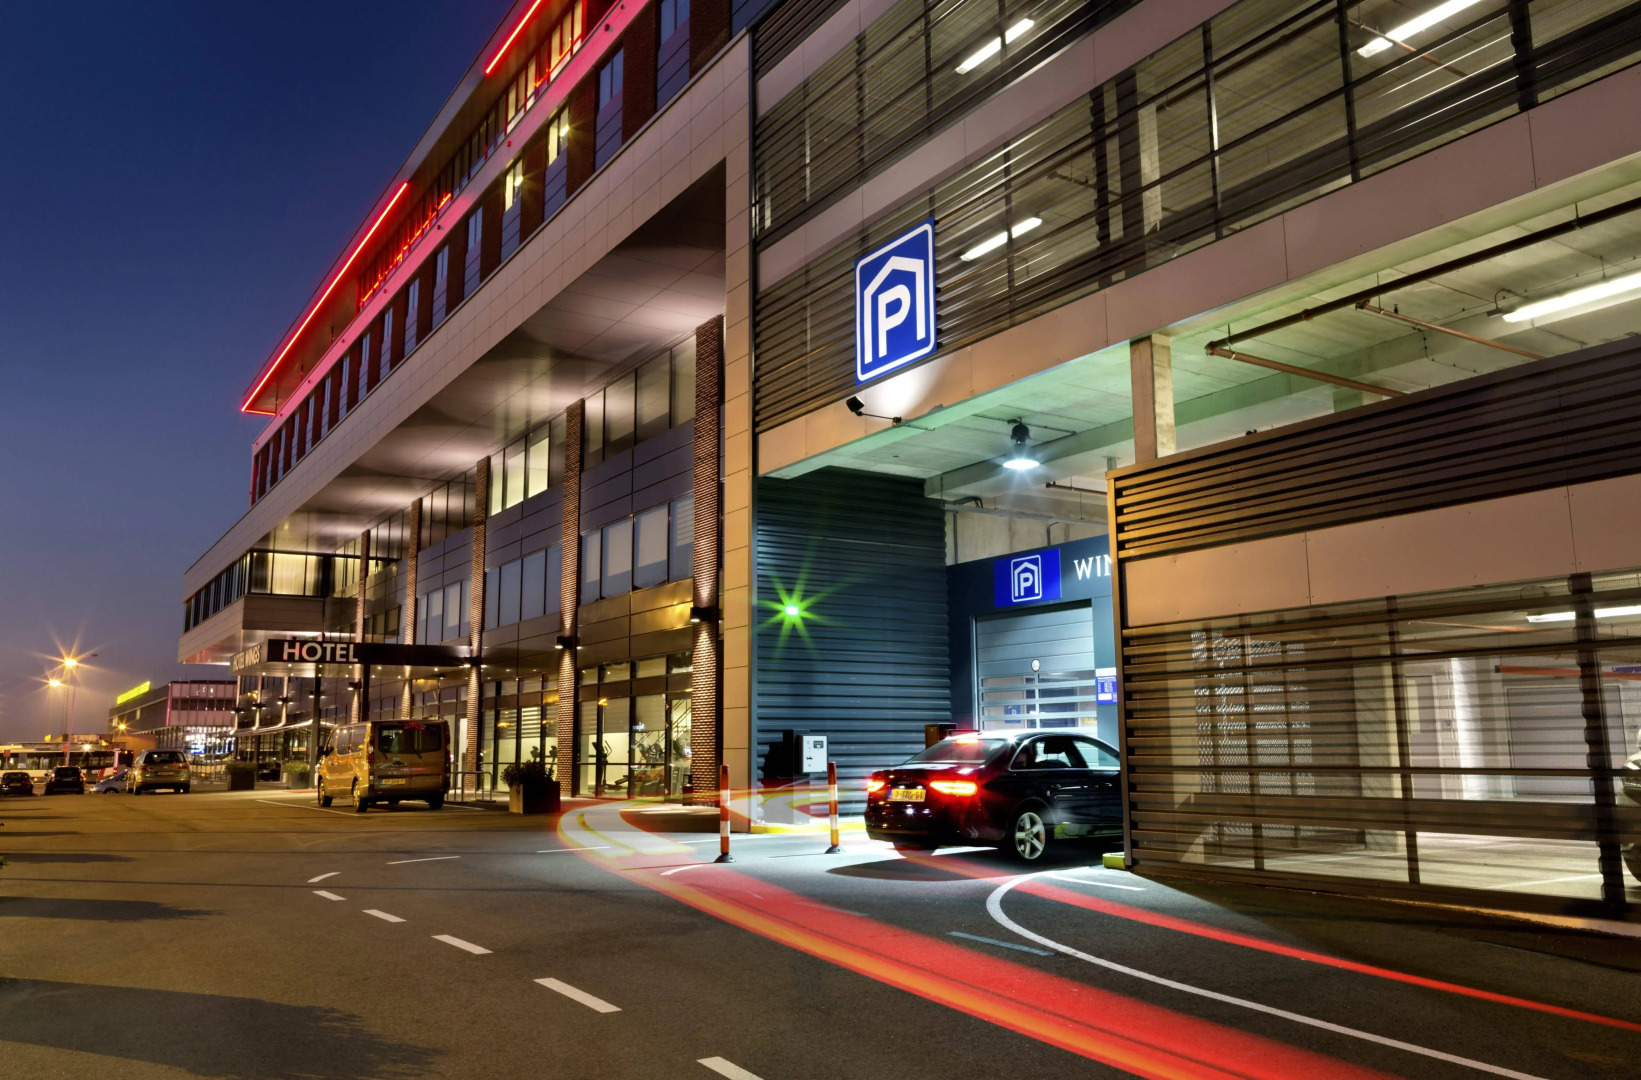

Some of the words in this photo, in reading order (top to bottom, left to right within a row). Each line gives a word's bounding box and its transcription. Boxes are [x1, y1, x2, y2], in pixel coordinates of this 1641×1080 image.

[878, 284, 911, 359] P
[1020, 573, 1033, 596] P
[233, 651, 245, 671] HOTEL
[283, 641, 359, 662] HOTEL
